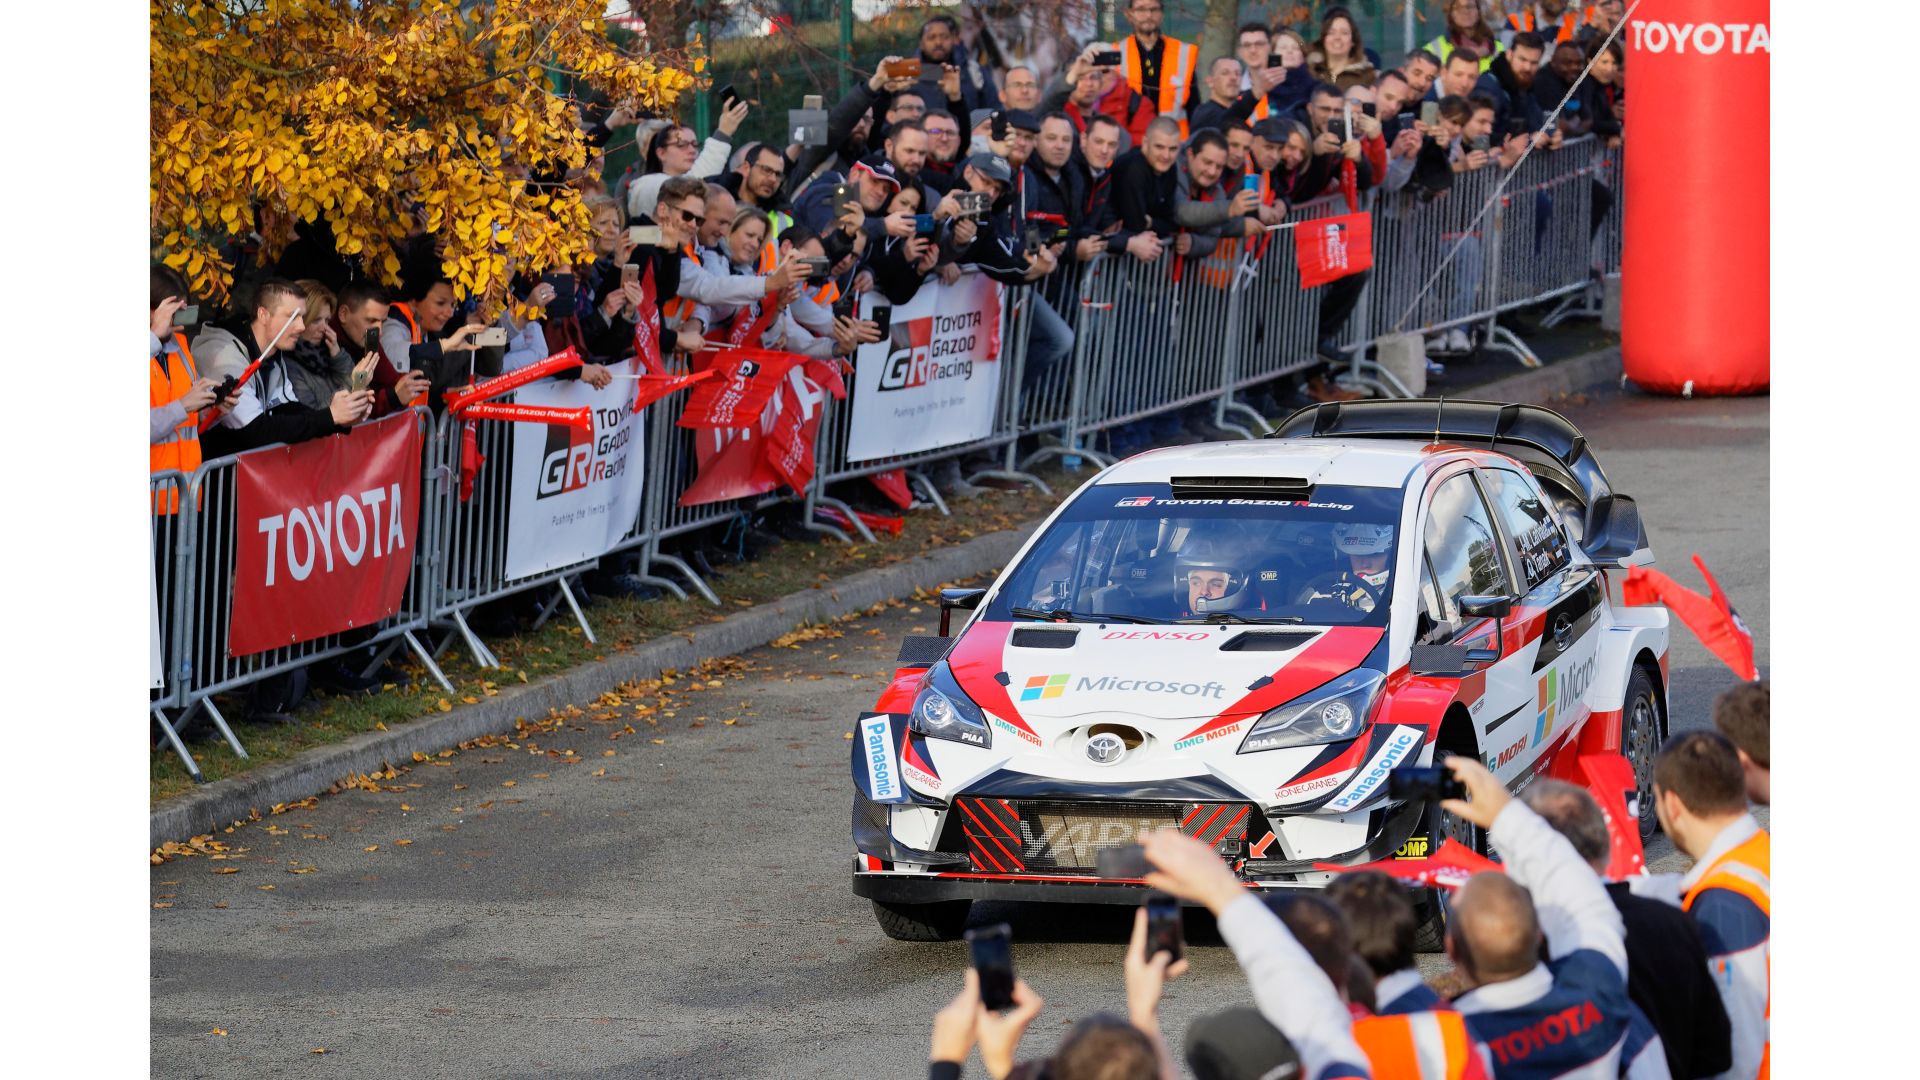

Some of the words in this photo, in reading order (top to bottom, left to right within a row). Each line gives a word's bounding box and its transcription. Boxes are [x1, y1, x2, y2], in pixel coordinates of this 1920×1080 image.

[1631, 20, 1770, 54] TOYOTA
[934, 310, 982, 334] TOYOTA
[932, 334, 976, 358] GAZOO
[476, 374, 508, 392] TOYOTA
[510, 362, 539, 378] GAZOO
[540, 352, 568, 368] Racing
[882, 345, 930, 389] GR
[929, 358, 973, 382] Racing
[483, 406, 515, 414] TOYOTA
[516, 408, 546, 416] GAZOO
[547, 410, 576, 420] Racing
[596, 398, 634, 430] TOYOTA
[597, 426, 630, 456] GAZOO
[540, 443, 593, 494] GR
[592, 453, 627, 482] Racing
[1294, 500, 1354, 510] Racing
[258, 482, 406, 587] TOYOTA
[1260, 571, 1278, 580] OMP
[1102, 632, 1210, 641] DENSO
[1076, 676, 1226, 699] Microsoft
[962, 732, 984, 744] PIAA
[994, 718, 1017, 735] DMG
[1018, 730, 1042, 748] MORI
[1174, 735, 1205, 752] DMG
[1206, 724, 1240, 742] MORI
[1249, 738, 1280, 748] PIAA
[868, 722, 896, 796] Panasonic
[1497, 733, 1528, 770] MORI
[1334, 734, 1412, 808] Panasonic
[1275, 777, 1339, 800] KONECRANES
[1020, 820, 1183, 858] YAR
[1395, 841, 1428, 858] OMP
[1489, 1000, 1603, 1066] TOYOTA
